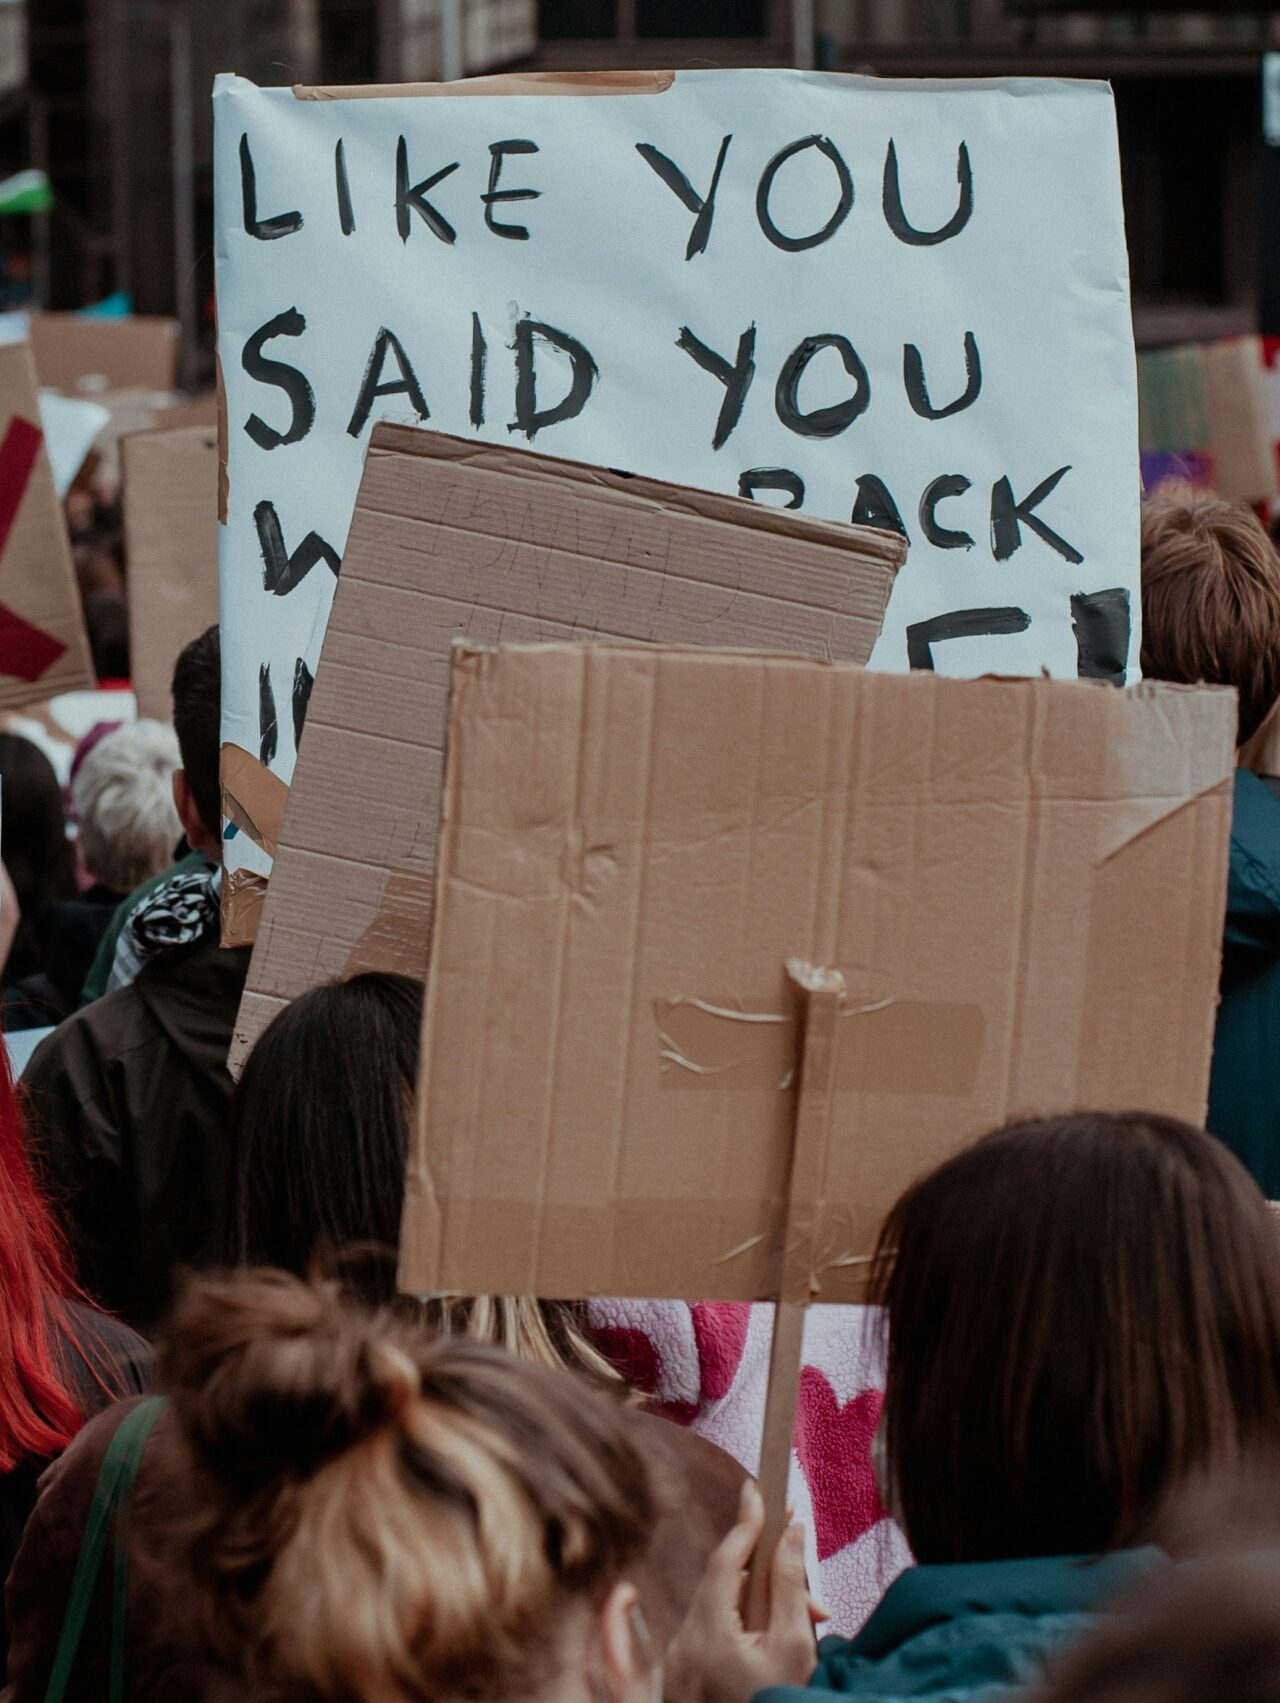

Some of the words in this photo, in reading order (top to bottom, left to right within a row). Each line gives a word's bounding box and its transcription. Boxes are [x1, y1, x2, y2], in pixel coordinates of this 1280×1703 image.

[239, 130, 544, 245] LIKE
[634, 133, 975, 261] YOU
[241, 302, 600, 451] SAID
[675, 320, 981, 449] YOU
